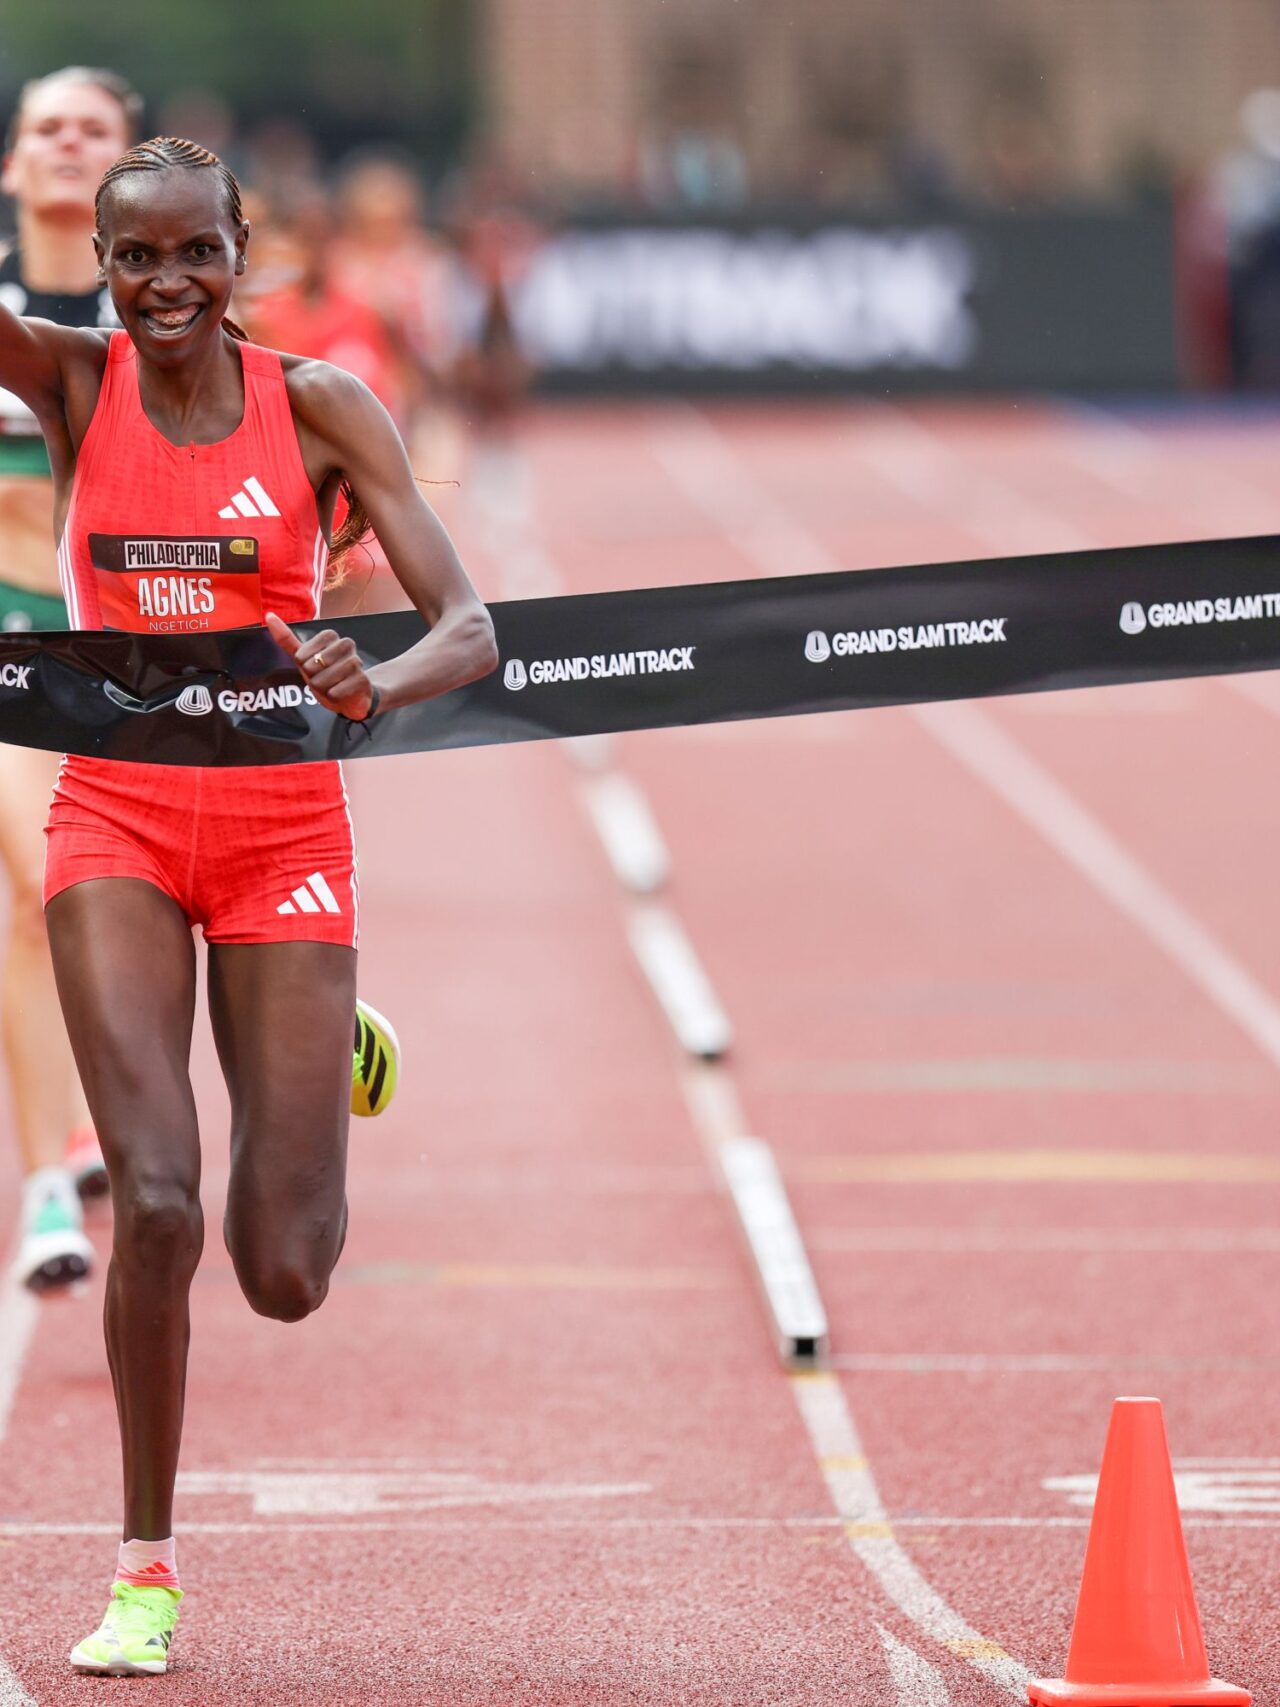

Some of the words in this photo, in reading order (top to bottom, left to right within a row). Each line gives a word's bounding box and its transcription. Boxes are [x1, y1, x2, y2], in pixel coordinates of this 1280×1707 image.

[128, 542, 218, 566] PHILADELPHIA
[137, 576, 215, 616] AGNES
[1147, 599, 1214, 628] GRAND
[1214, 595, 1263, 622] SLAM
[148, 618, 209, 632] NGETICH
[832, 628, 897, 656] GRAND
[897, 624, 945, 650] SLAM
[945, 618, 1007, 646] TRACK
[529, 657, 590, 684] GRAND
[590, 652, 635, 678] SLAM
[636, 647, 695, 674] TRACK
[218, 685, 302, 712] GRAND
